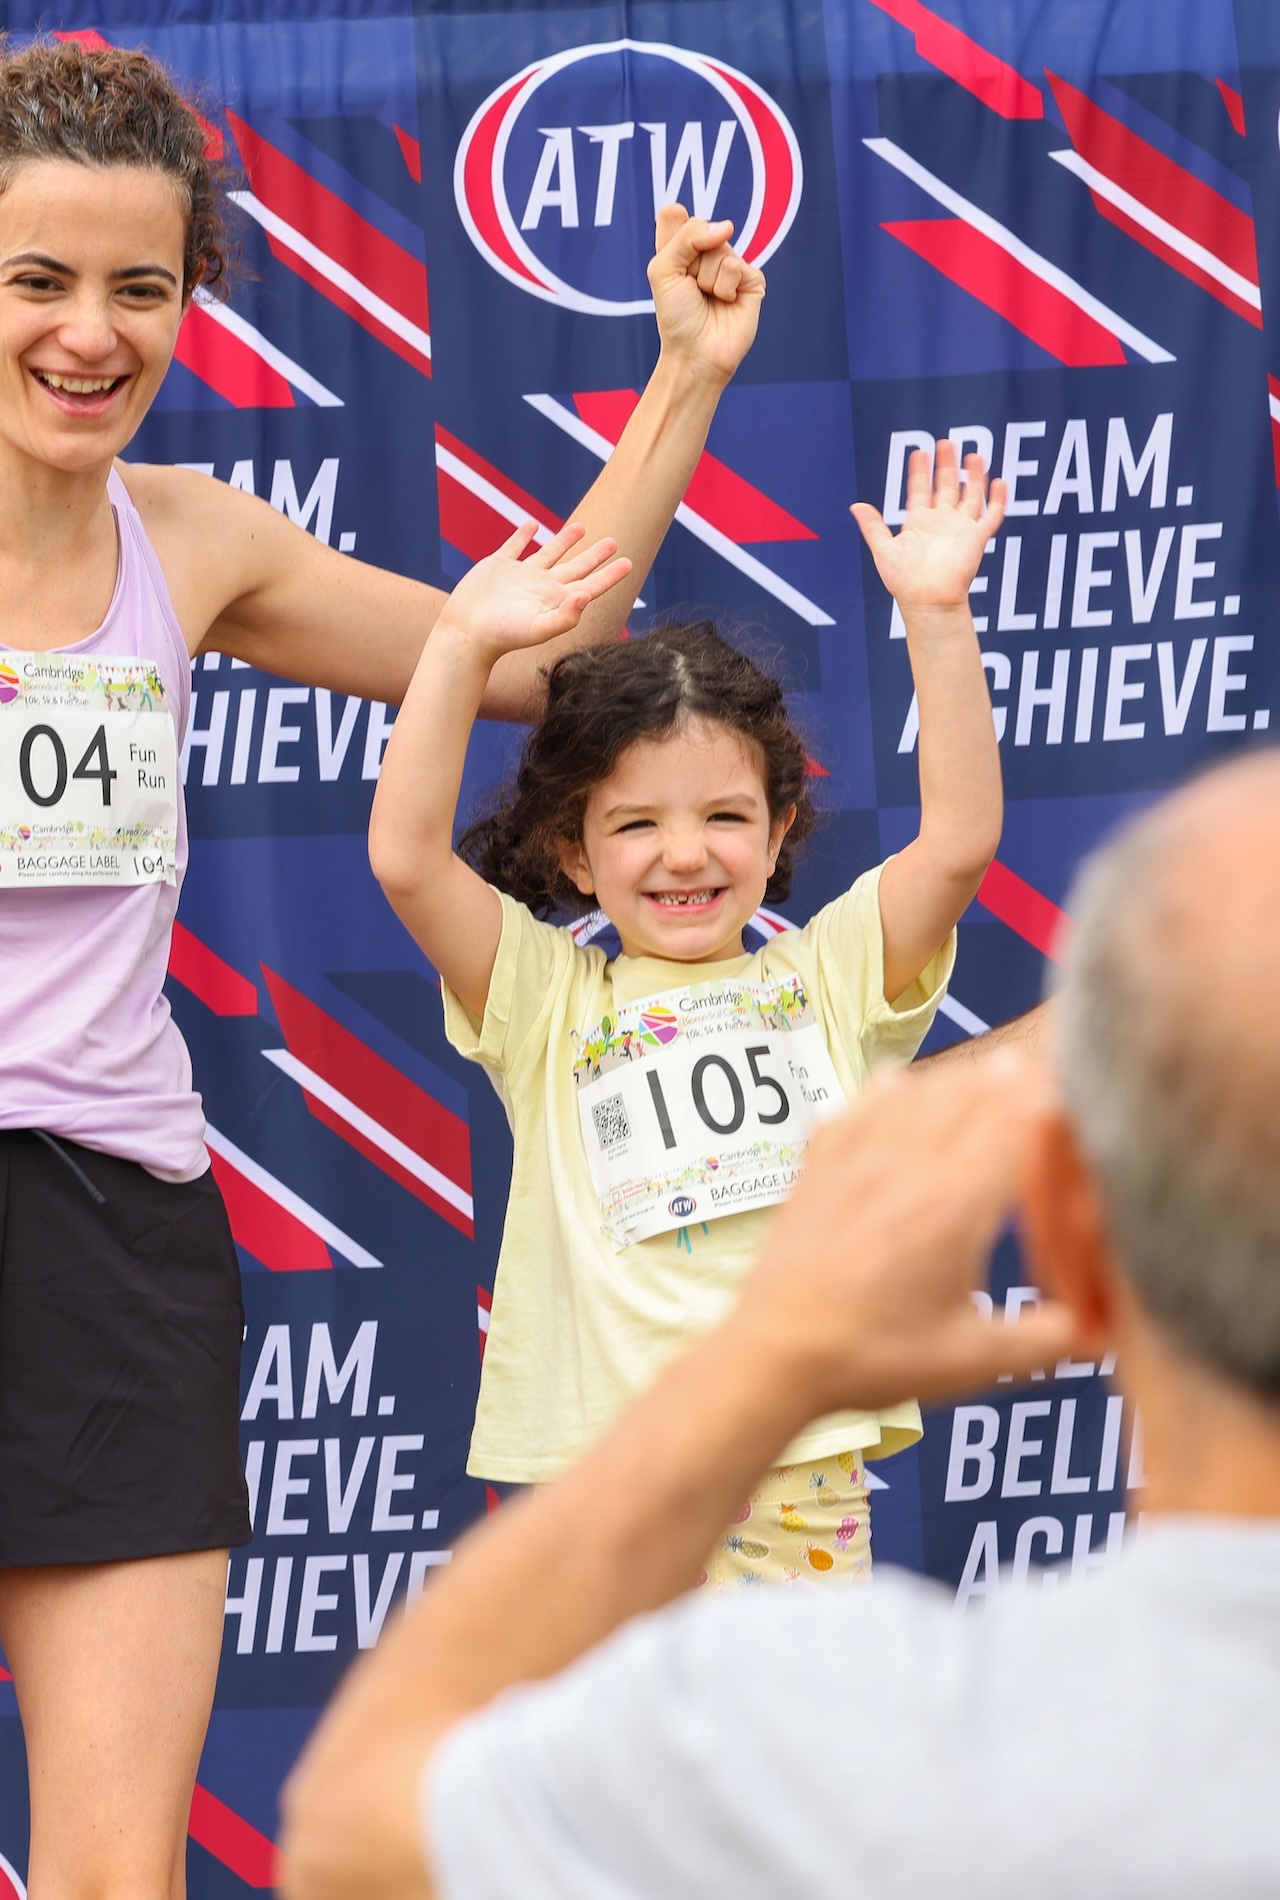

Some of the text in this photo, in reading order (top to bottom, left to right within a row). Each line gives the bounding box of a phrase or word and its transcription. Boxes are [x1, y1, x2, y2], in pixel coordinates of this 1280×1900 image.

[520, 120, 738, 230] ATW
[23, 662, 84, 684] Cambridge
[129, 743, 157, 763] Fun
[137, 769, 167, 790] Run
[32, 824, 74, 836] Cambridge
[17, 854, 120, 871] BAGGAGE LABEL
[678, 989, 743, 1012] Cambridge
[645, 1045, 791, 1150] 105
[800, 1085, 829, 1103] Run
[710, 1173, 782, 1201] BAGGAGE
[672, 1198, 693, 1214] ATW
[240, 1320, 395, 1420] AM.
